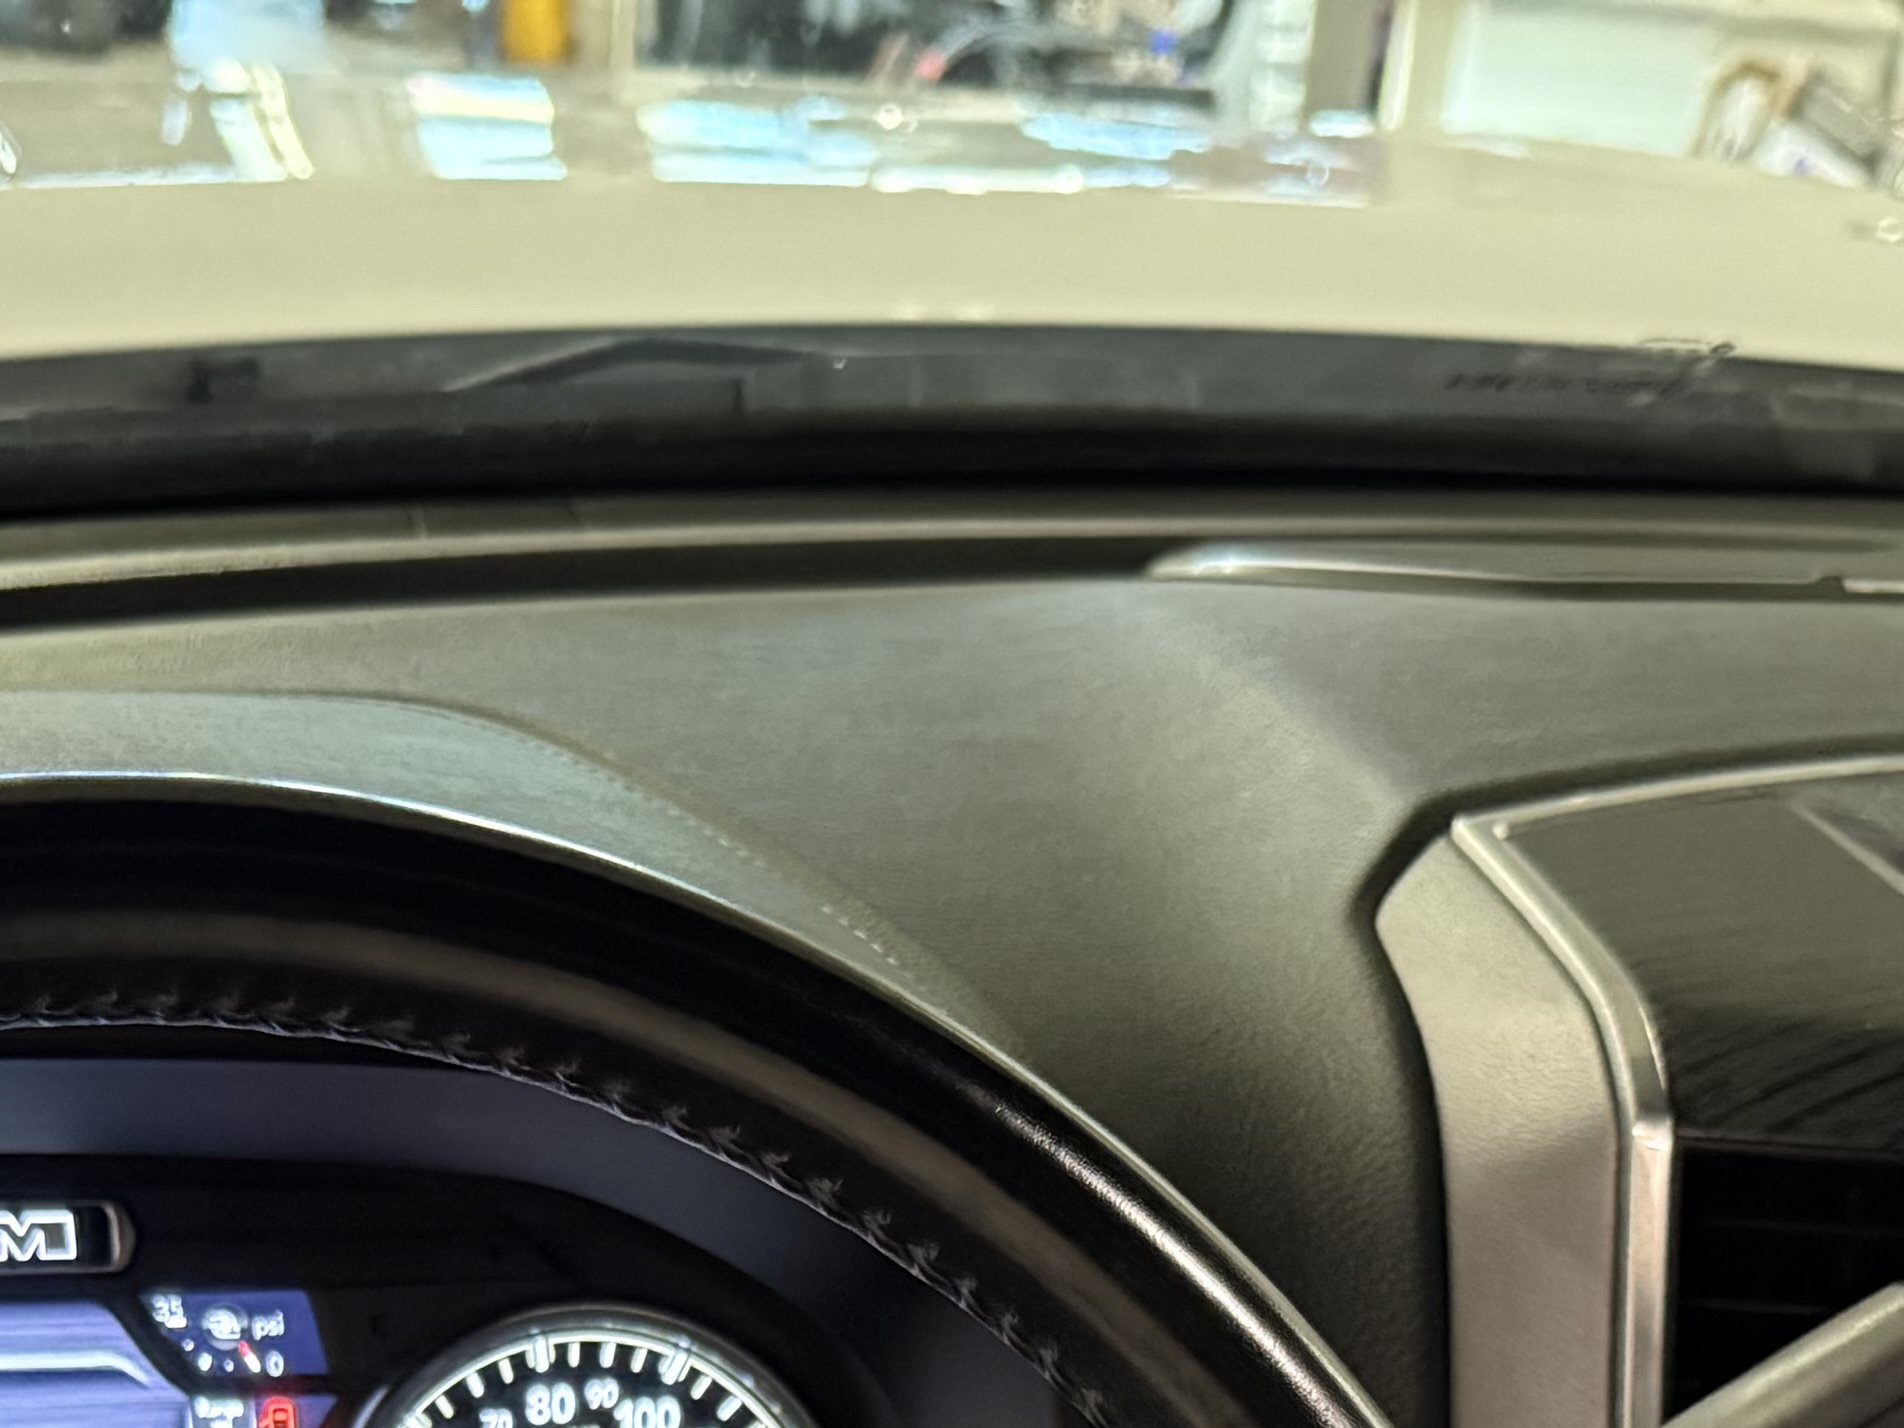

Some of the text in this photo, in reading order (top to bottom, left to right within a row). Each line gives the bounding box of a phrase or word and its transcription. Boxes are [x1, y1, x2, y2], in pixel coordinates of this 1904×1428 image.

[251, 1310, 284, 1340] psi
[265, 1351, 284, 1377] 0
[525, 1382, 575, 1425] 80
[584, 1377, 619, 1410] 90
